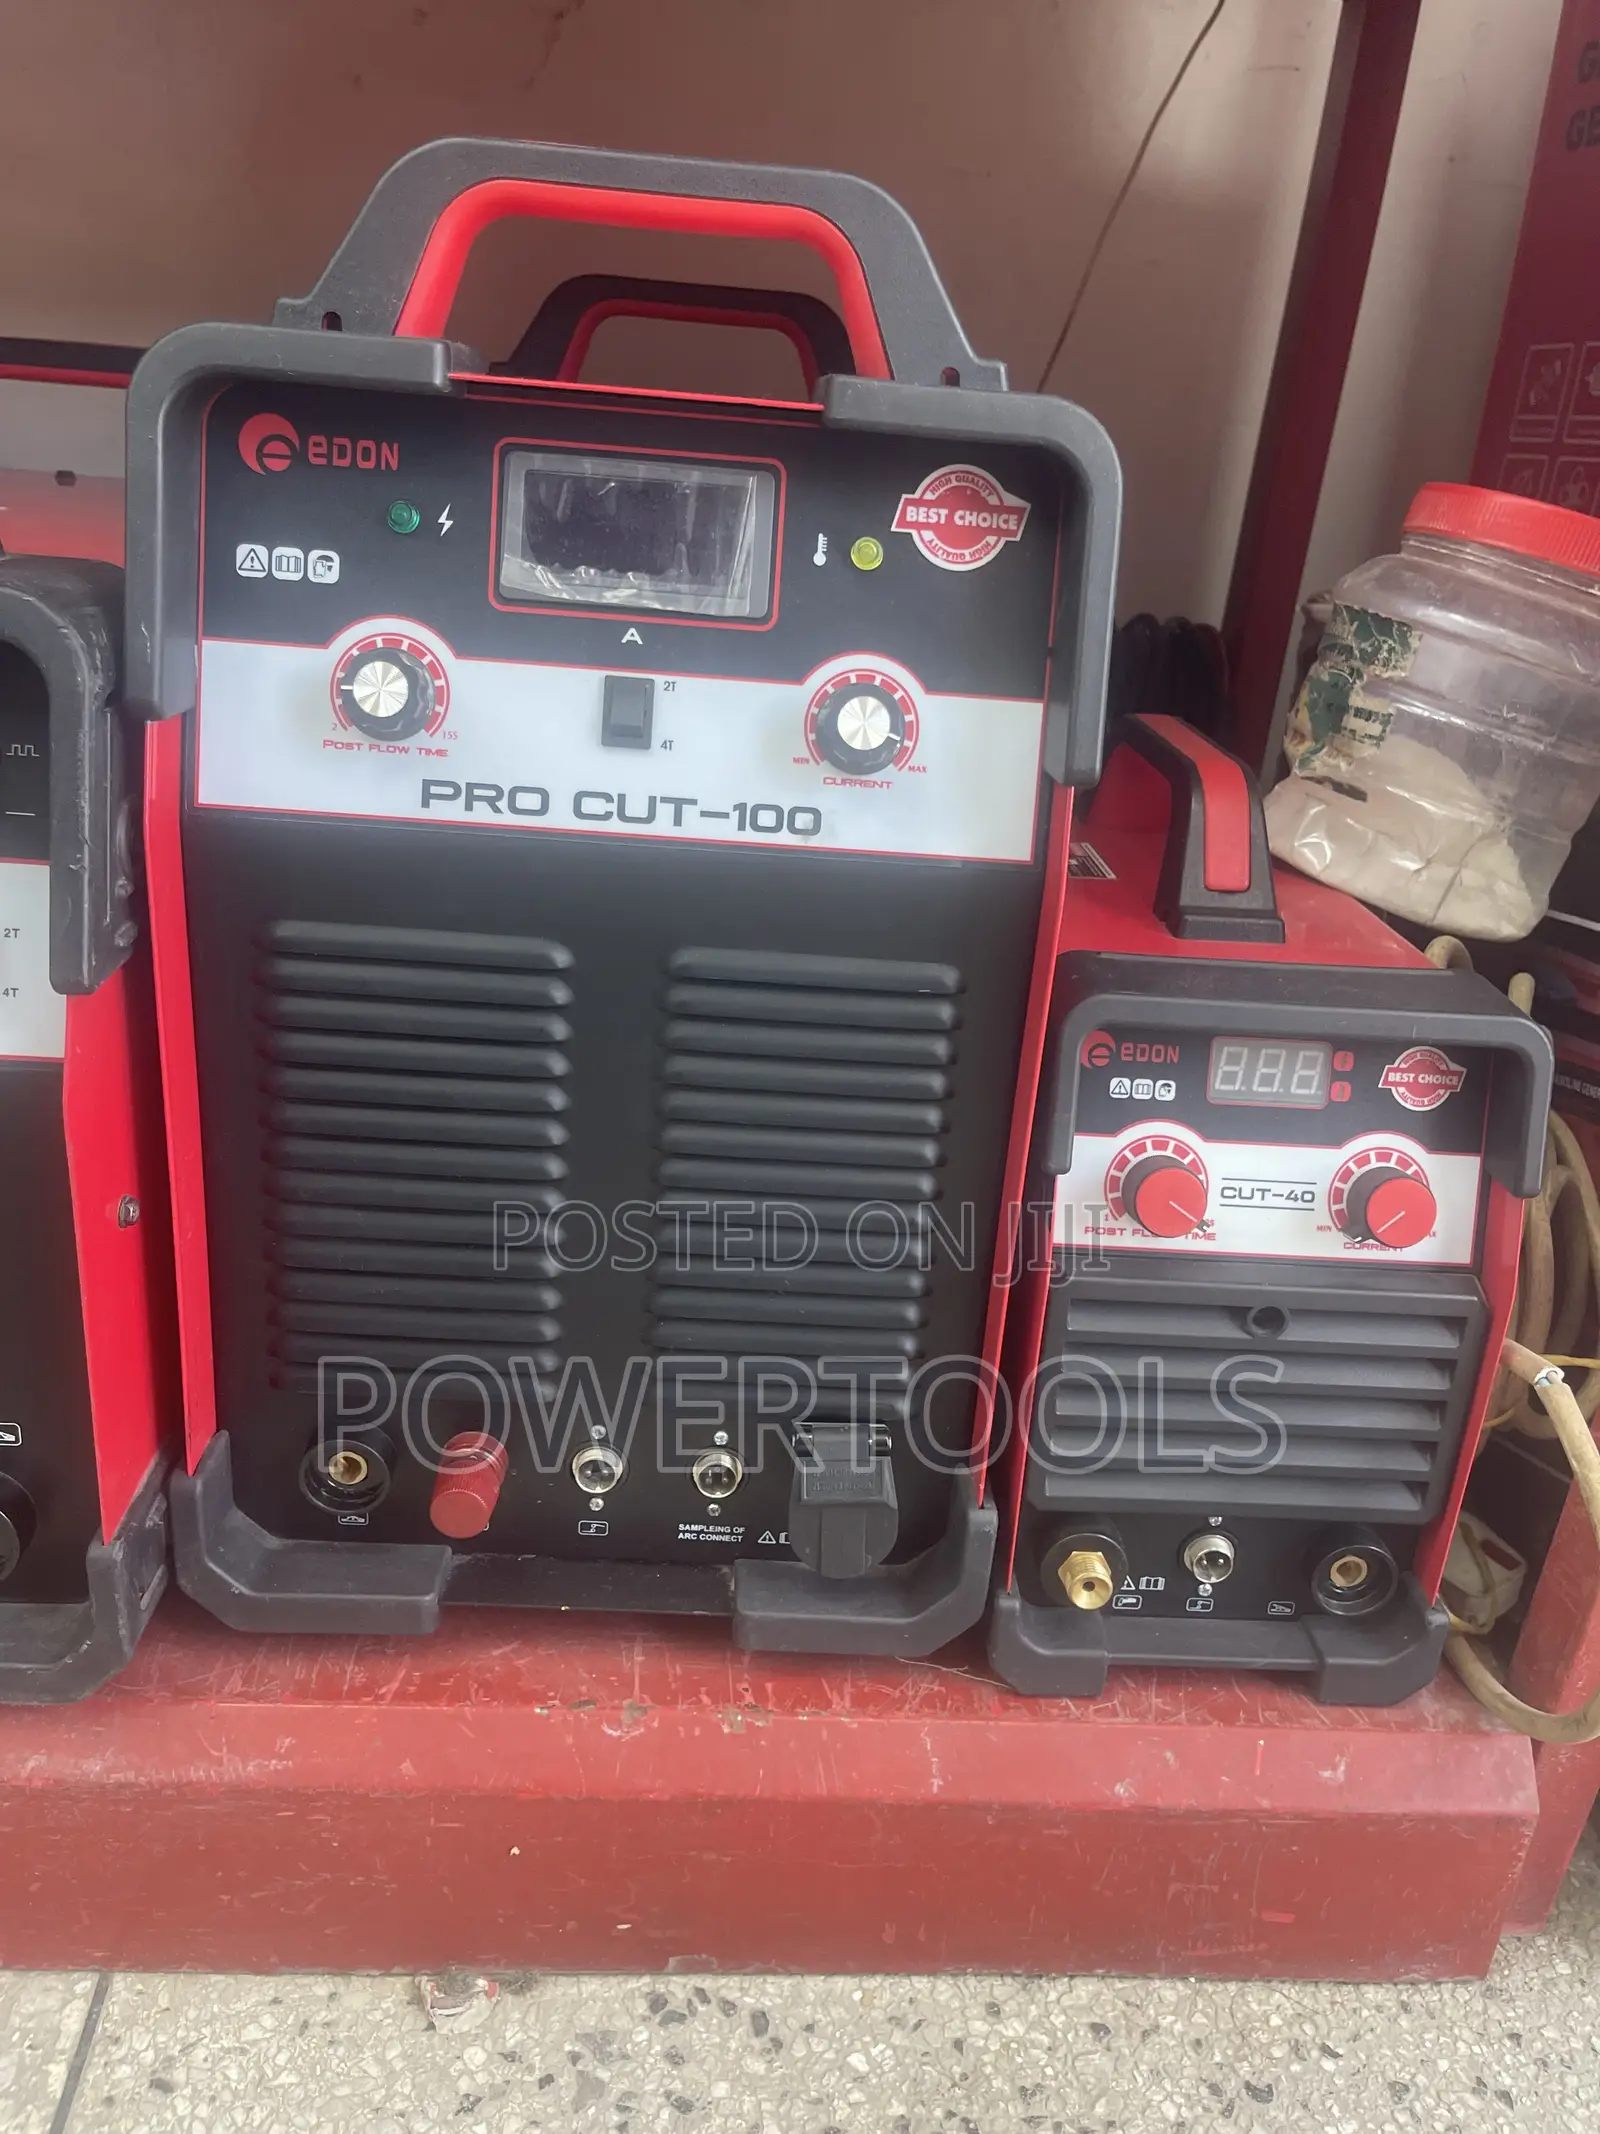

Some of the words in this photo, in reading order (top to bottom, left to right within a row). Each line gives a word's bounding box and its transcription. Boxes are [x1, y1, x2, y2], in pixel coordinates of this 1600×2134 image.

[929, 475, 953, 496] HIGH
[954, 473, 995, 498] QUALITY
[905, 505, 949, 525] BEST
[953, 509, 1018, 530] CHOICE
[621, 627, 643, 645] A
[663, 681, 677, 692] 2T
[322, 739, 364, 751] POST
[368, 743, 410, 755] FLOW
[416, 747, 449, 758] TIME
[660, 739, 674, 752] 4T
[793, 756, 810, 765] MIN
[908, 765, 927, 774] MAX
[822, 776, 893, 789] CURRENT
[421, 778, 550, 818] PRO
[573, 790, 823, 837] CUT-100
[3, 927, 21, 939] 2T
[2, 987, 20, 998] 4T
[1387, 1071, 1416, 1084] BEST
[1417, 1073, 1459, 1086] CHOICE
[1220, 1186, 1315, 1203] CUT-40
[1084, 1226, 1127, 1237] POST
[1316, 1224, 1333, 1233] MIN
[678, 1523, 731, 1533] SAMPLEING
[732, 1526, 746, 1534] OF
[677, 1532, 698, 1540] ARC
[699, 1533, 743, 1543] CONNECT
